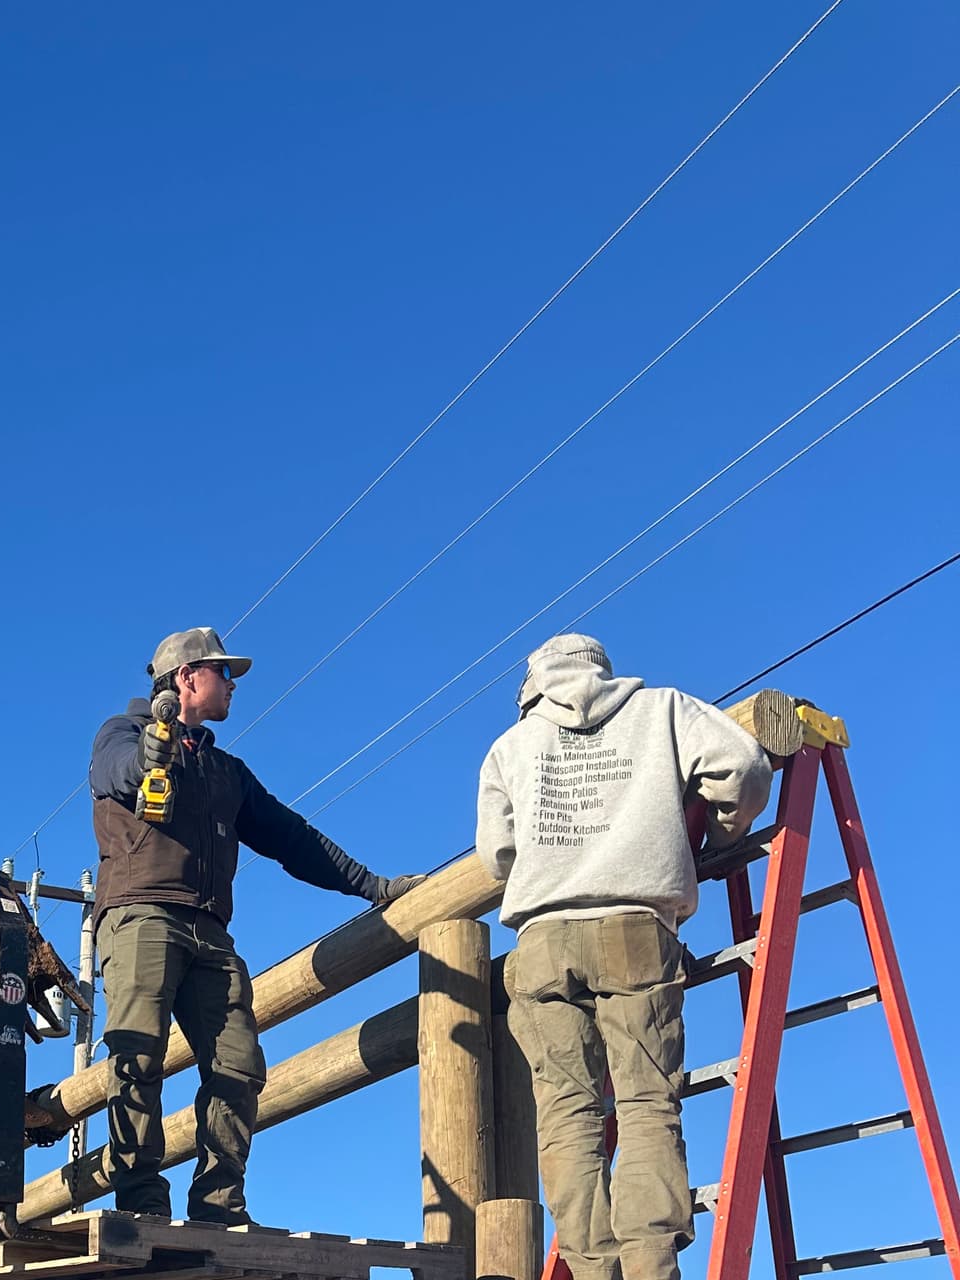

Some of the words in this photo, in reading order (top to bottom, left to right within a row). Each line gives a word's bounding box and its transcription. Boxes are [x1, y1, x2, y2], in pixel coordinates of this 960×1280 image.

[540, 752, 562, 762] Lawn
[564, 748, 617, 761] Maintenance
[541, 763, 584, 775] Landscape
[586, 758, 633, 771] Installation
[541, 775, 583, 787] Hardscape
[585, 771, 632, 783] Installation
[540, 786, 570, 799] Custom
[572, 786, 598, 799] Patios
[540, 798, 578, 812] Retaining
[580, 798, 604, 810] Walls
[539, 809, 555, 820] Fire
[557, 812, 572, 823] Pits
[538, 822, 571, 833] Outdoor
[573, 823, 610, 835] Kitchens
[538, 835, 555, 846] And
